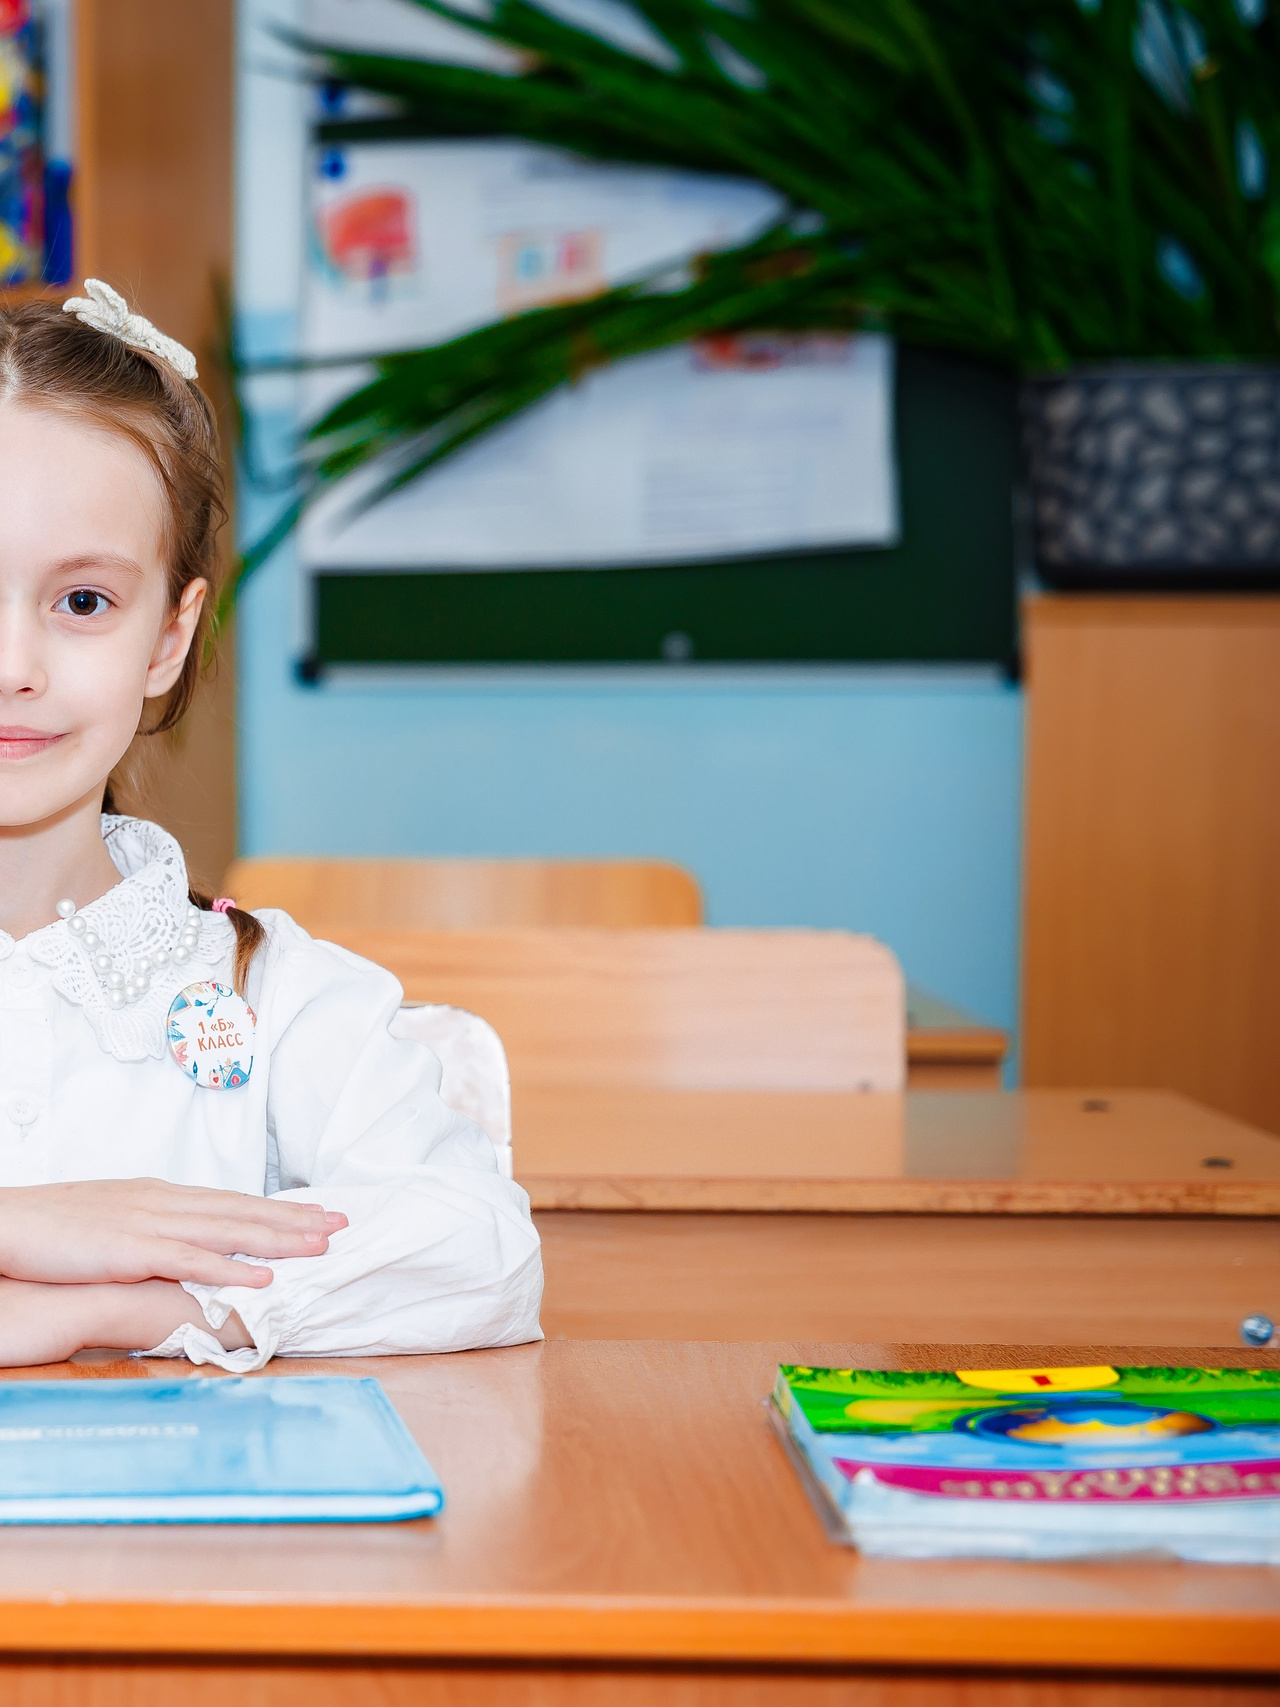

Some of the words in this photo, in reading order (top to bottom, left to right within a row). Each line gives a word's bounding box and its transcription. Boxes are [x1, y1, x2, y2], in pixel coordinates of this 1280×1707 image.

[198, 1021, 206, 1034] 1
[210, 1018, 235, 1032] «Б»
[197, 1032, 244, 1051] КЛАСС
